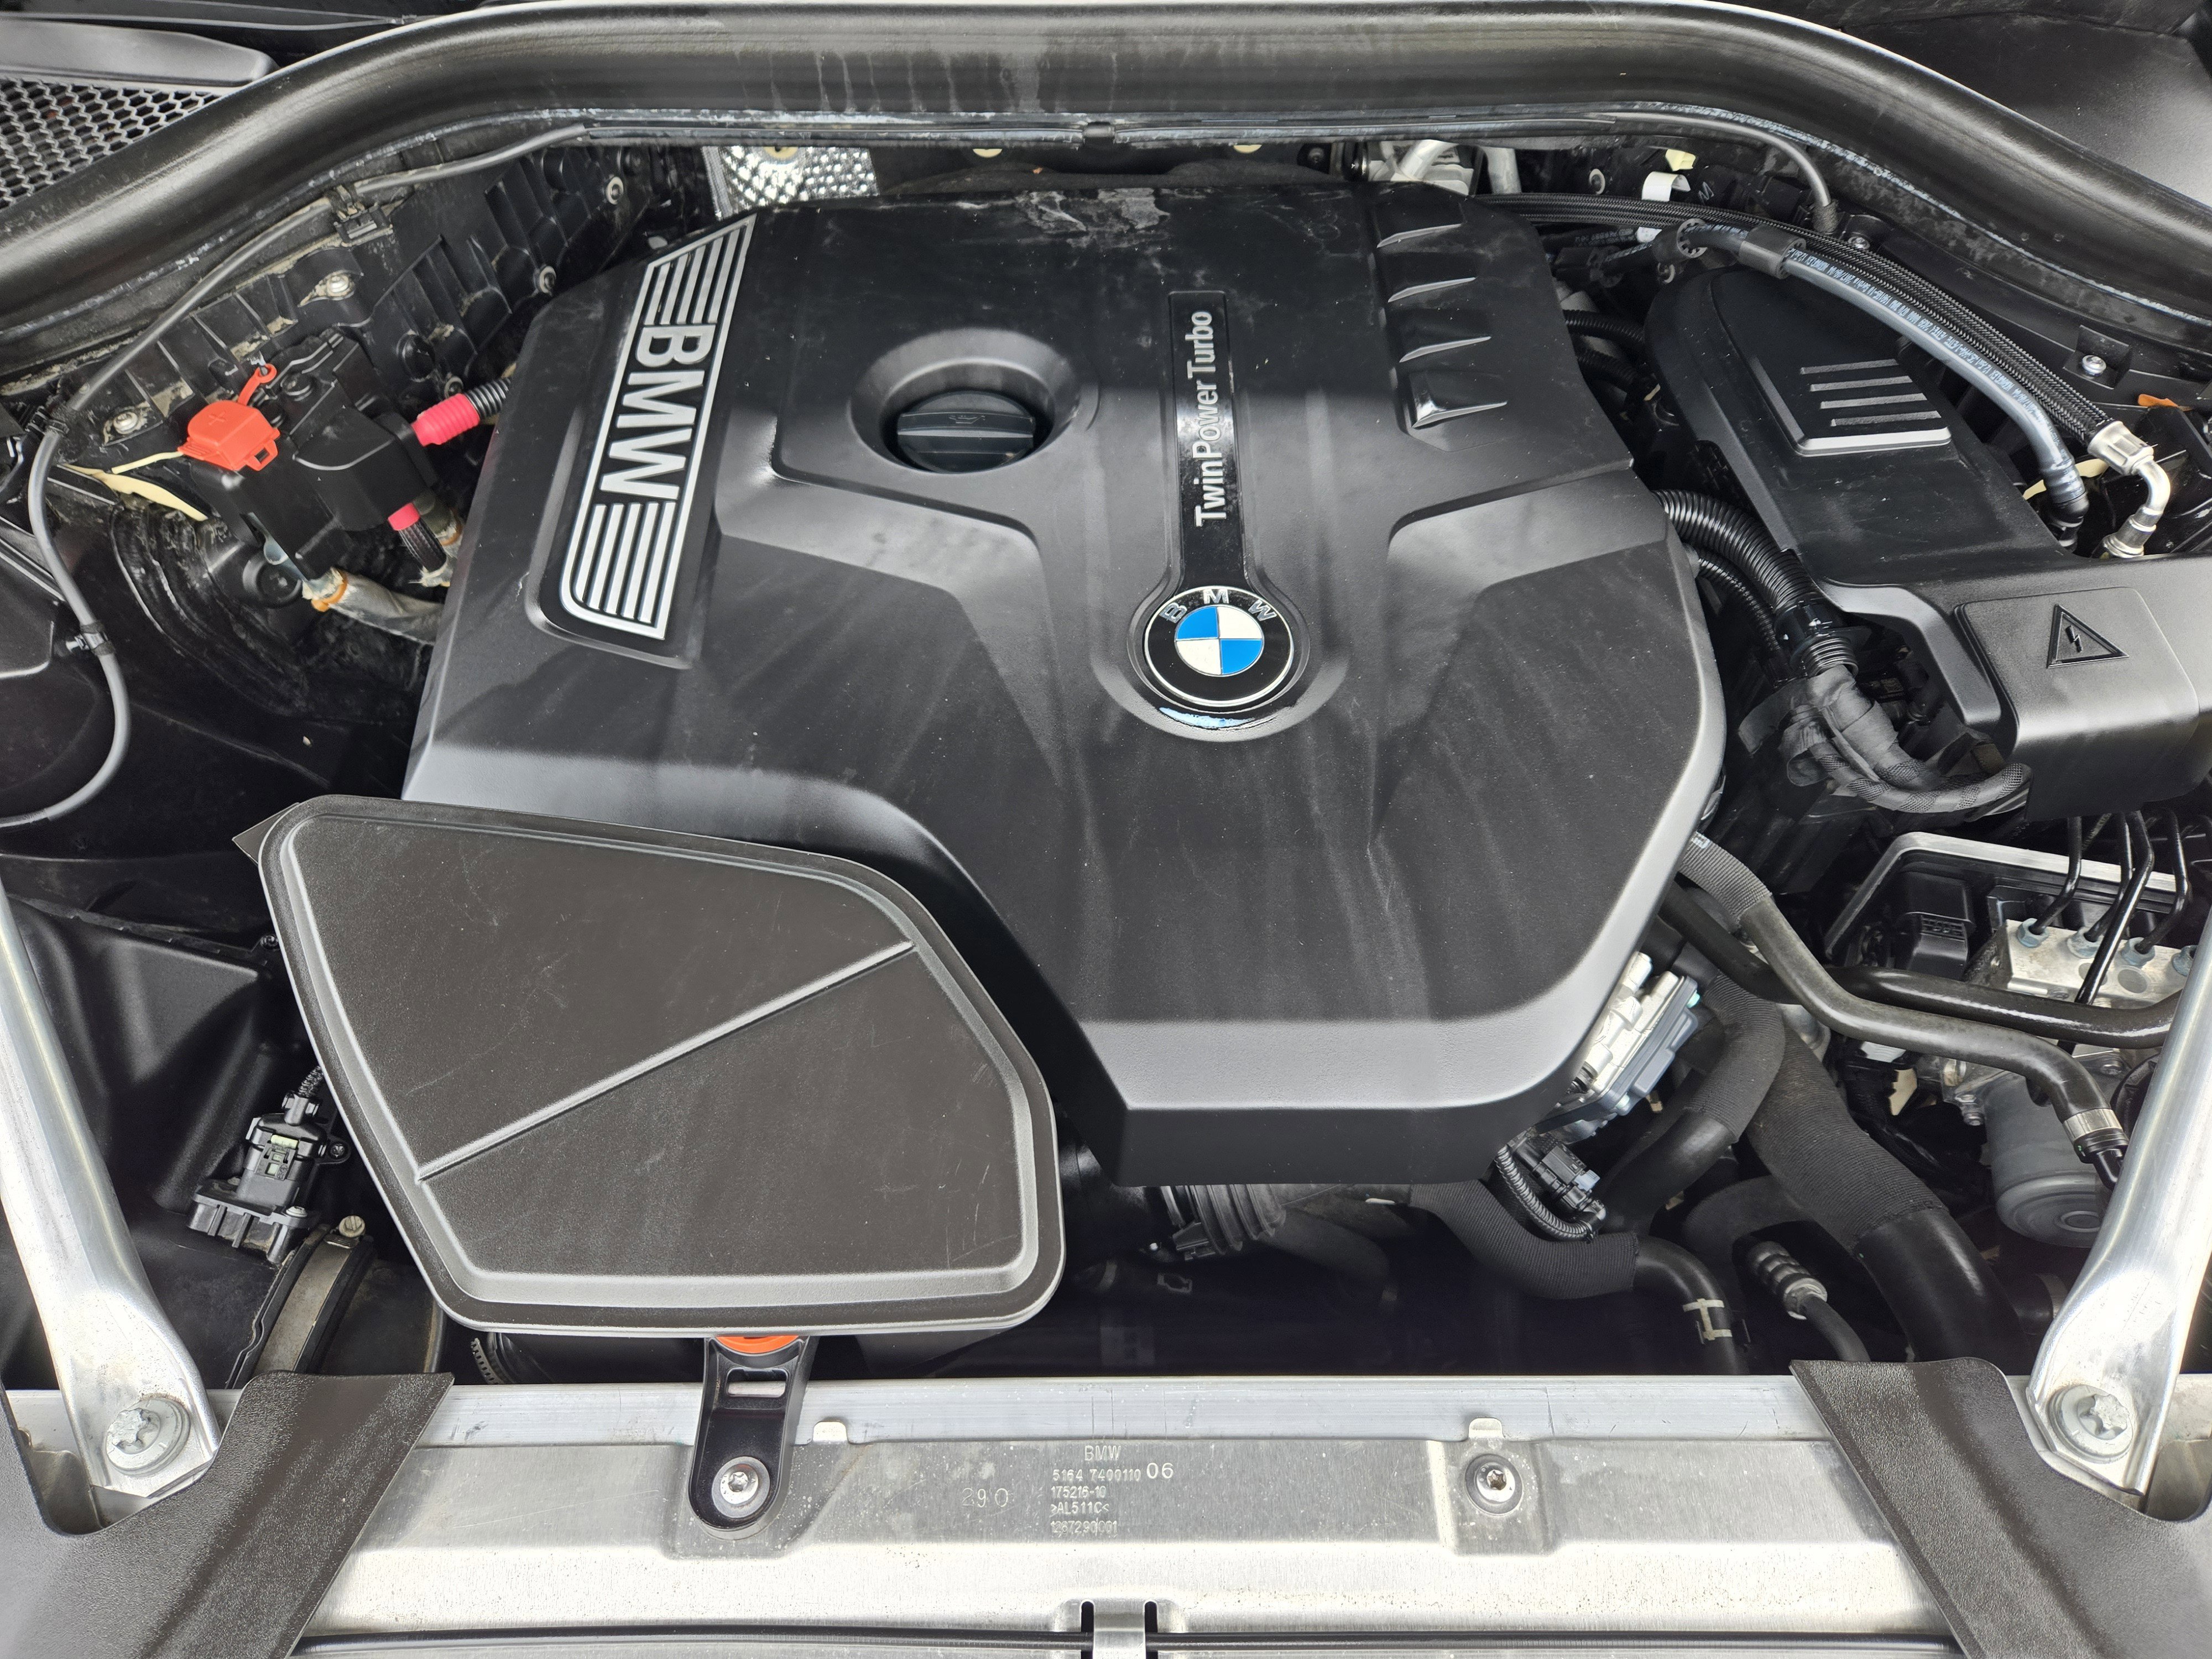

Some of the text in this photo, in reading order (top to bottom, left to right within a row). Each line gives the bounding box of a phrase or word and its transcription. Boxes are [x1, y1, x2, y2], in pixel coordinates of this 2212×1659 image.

[600, 325, 715, 499] BMW
[1185, 311, 1227, 527] TwinPower Turbo
[1159, 588, 1277, 622] BMW
[1084, 1445, 1121, 1462] BMW
[1052, 1468, 1083, 1483] 5164
[1146, 1463, 1174, 1479] 06
